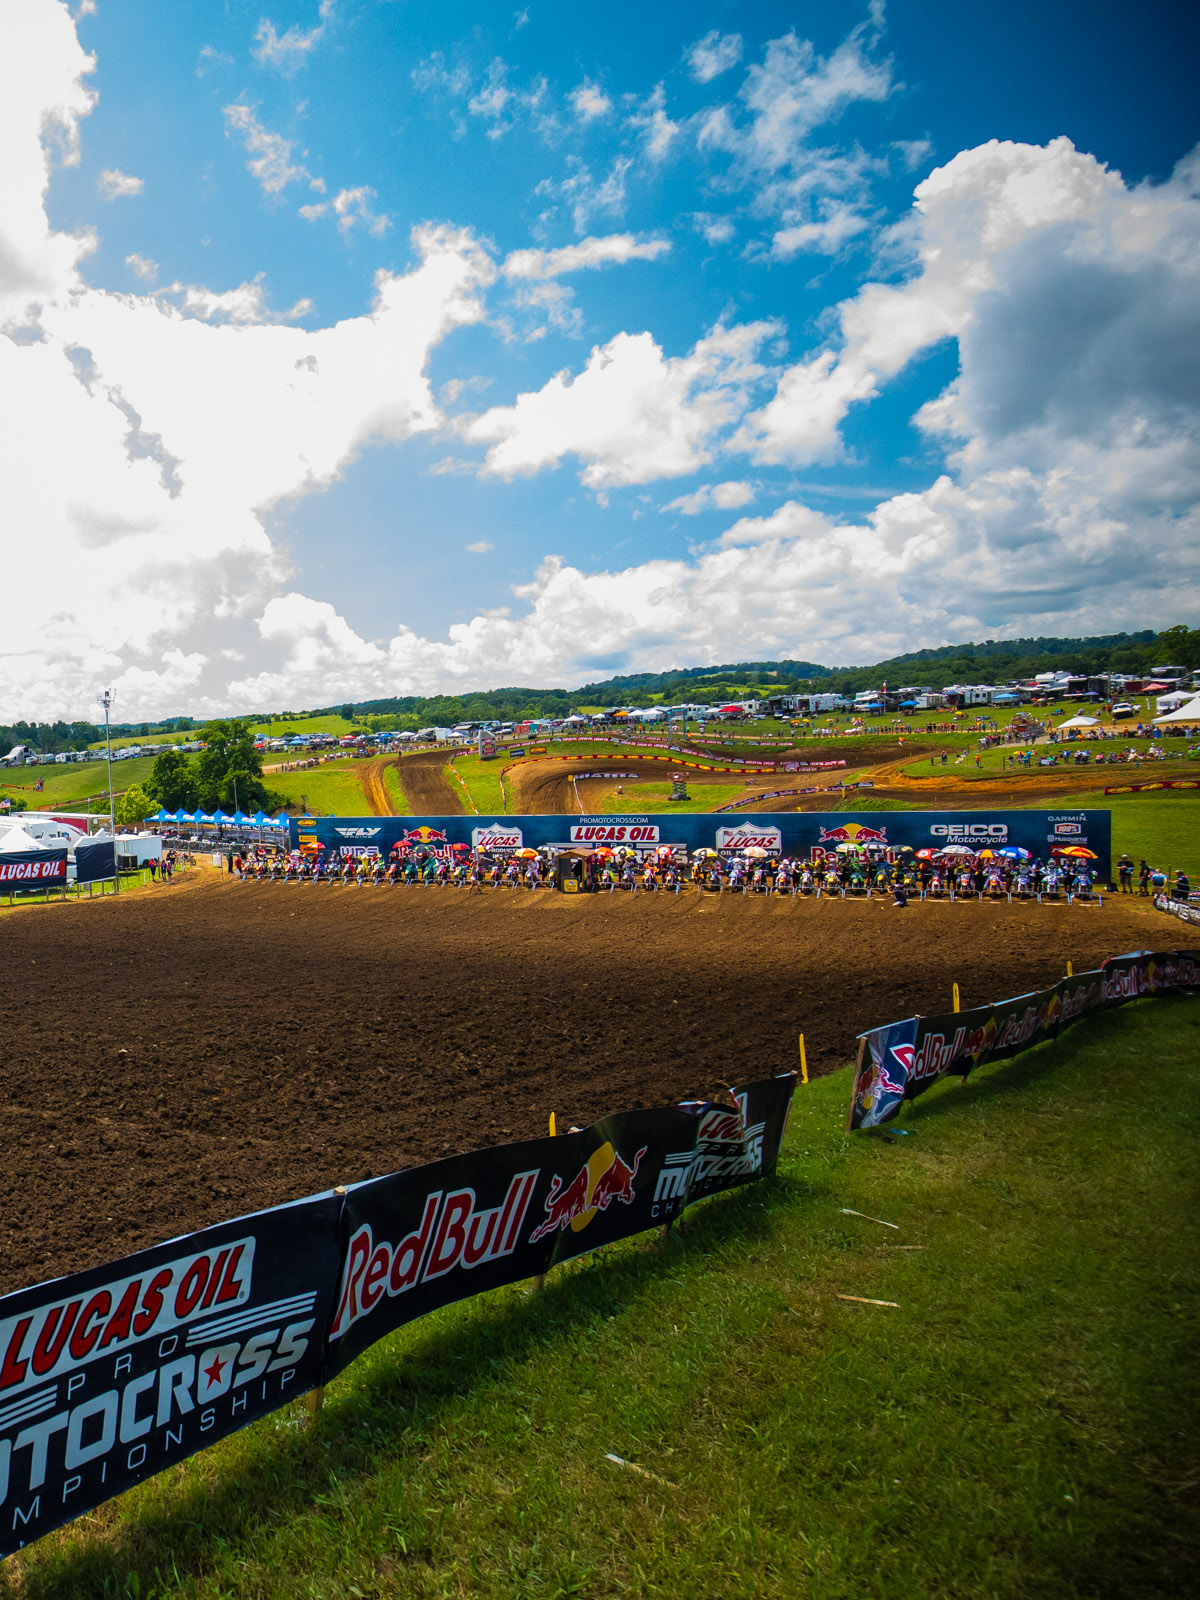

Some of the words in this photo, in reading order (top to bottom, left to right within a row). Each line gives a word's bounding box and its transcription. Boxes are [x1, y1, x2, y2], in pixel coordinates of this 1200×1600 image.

[334, 828, 382, 836] FLY
[574, 827, 627, 840] LUCAS
[629, 827, 656, 840] OIL
[930, 824, 1008, 836] GEICO
[478, 836, 520, 846] LUCAS
[724, 837, 777, 848] LUCAS
[946, 836, 1008, 844] Motorcycle
[0, 862, 40, 880] LUCAS
[42, 862, 60, 876] OIL
[174, 1244, 243, 1318] OIL
[66, 1334, 179, 1401] PRO
